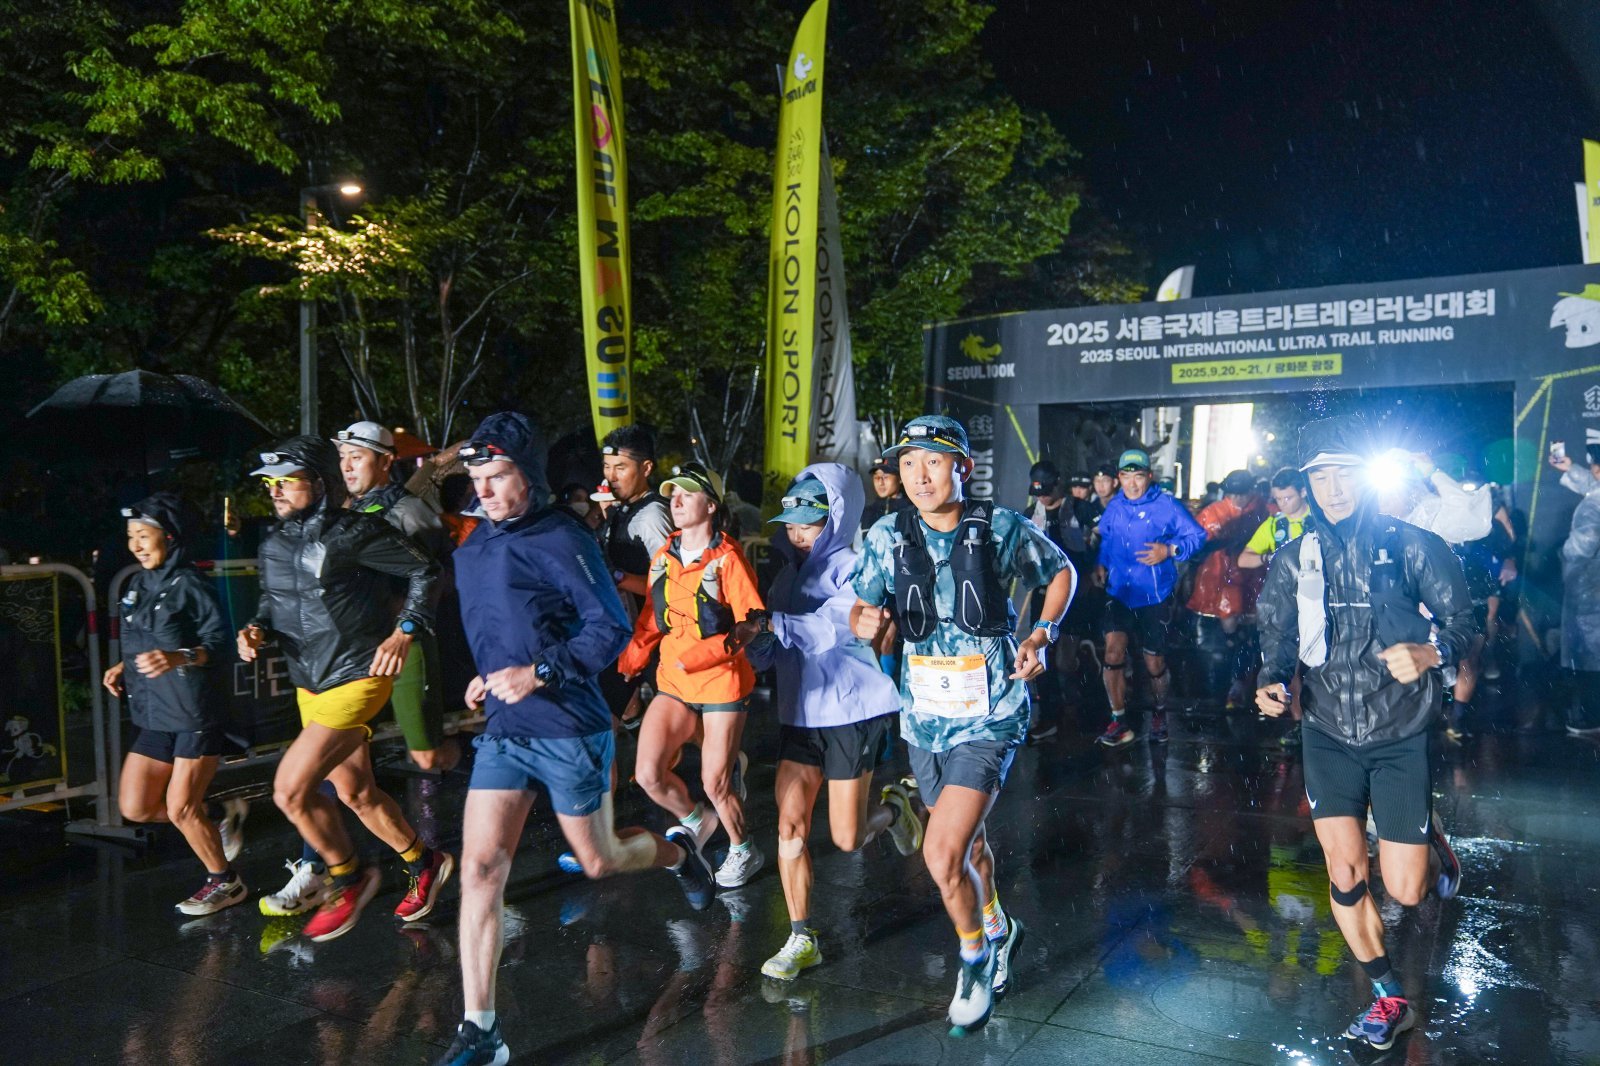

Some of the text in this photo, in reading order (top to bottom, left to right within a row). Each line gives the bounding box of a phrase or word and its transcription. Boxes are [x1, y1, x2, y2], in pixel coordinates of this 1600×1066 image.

[782, 182, 801, 444] KOLON SPORT
[1047, 288, 1496, 347] 2025 서울국제울트라트레일러닝대회
[1080, 324, 1455, 364] 2025 SEOUL INTERNATIONAL ULTRA TRAIL RUNNING
[1275, 360, 1308, 374] 광화문
[1312, 359, 1335, 371] 광장
[940, 675, 950, 689] 3
